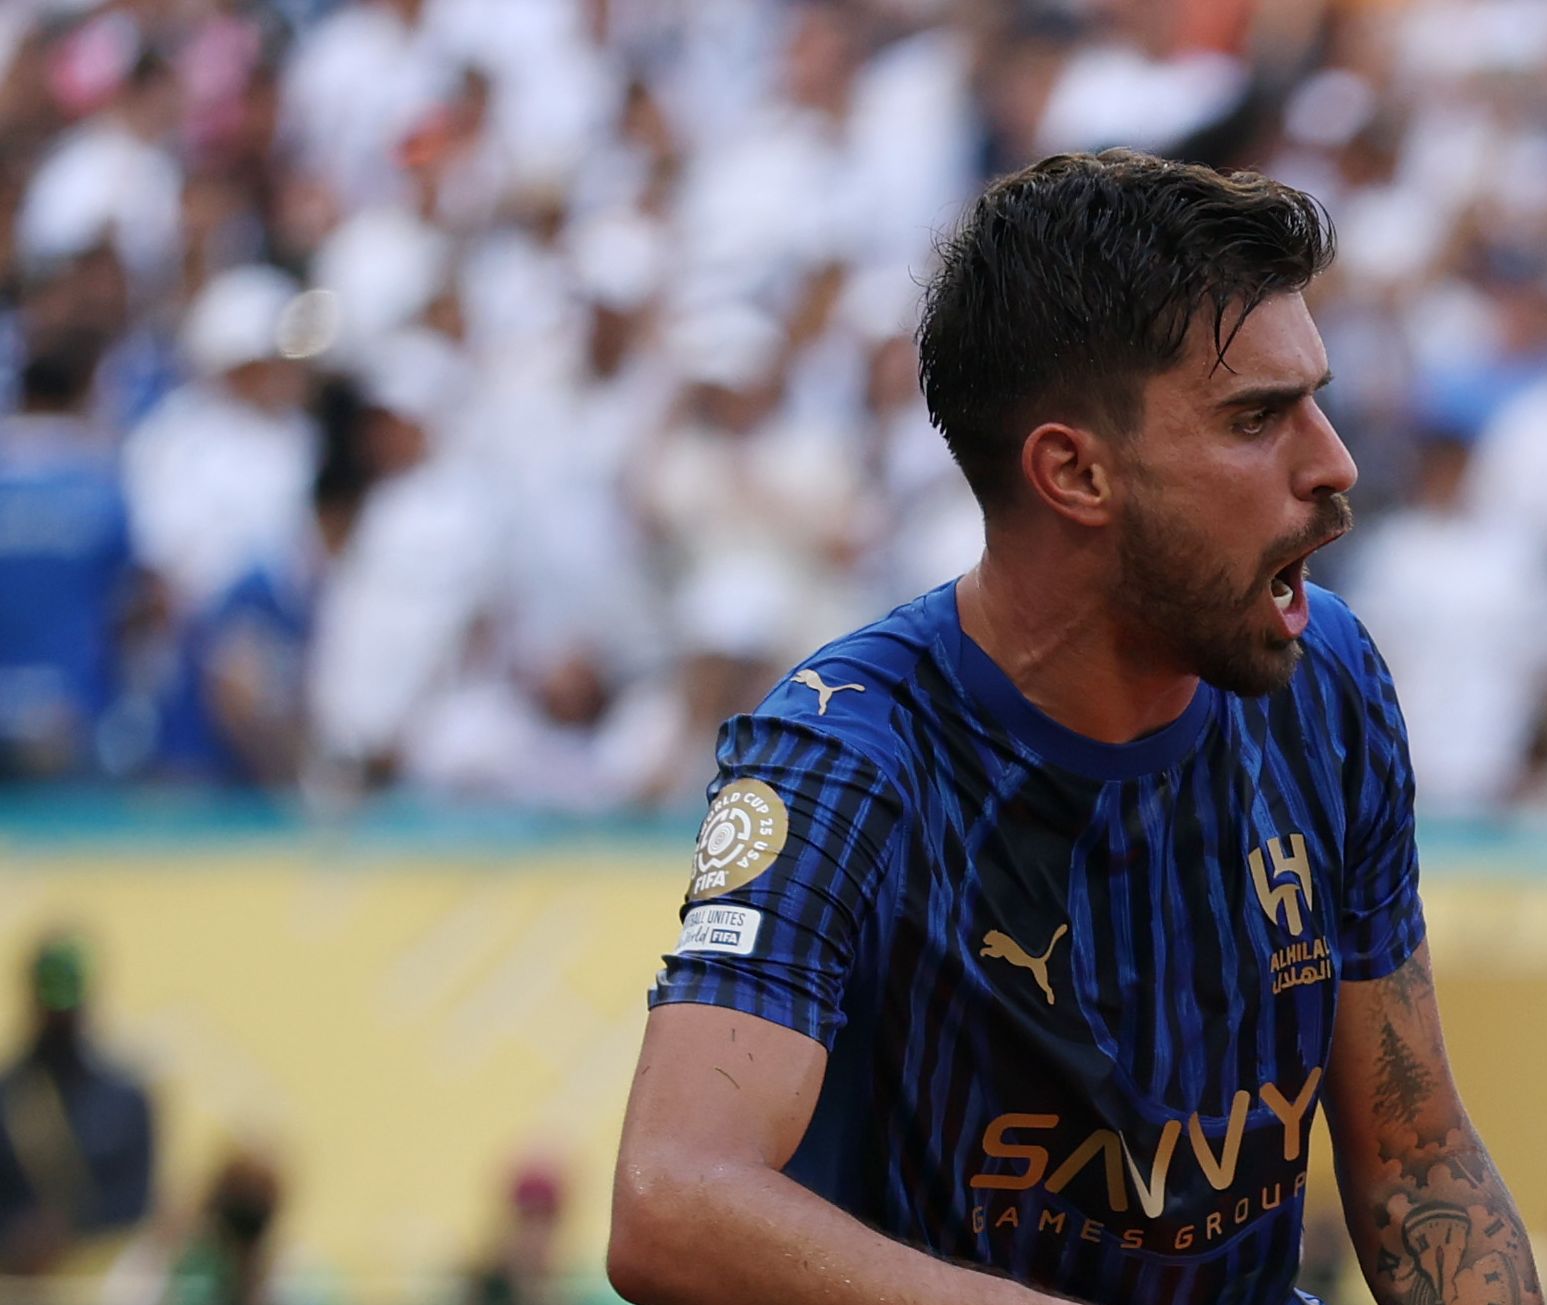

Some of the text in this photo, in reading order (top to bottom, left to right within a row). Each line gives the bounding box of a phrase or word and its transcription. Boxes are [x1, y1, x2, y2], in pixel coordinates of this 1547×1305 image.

[743, 792, 769, 814] CUP
[759, 818, 773, 836] 25
[736, 841, 768, 868] USA
[693, 870, 726, 895] FIFA
[707, 909, 746, 927] UNITES
[711, 929, 741, 946] FIFA
[970, 1067, 1322, 1218] SAVVY
[971, 1206, 1146, 1249] GAMES
